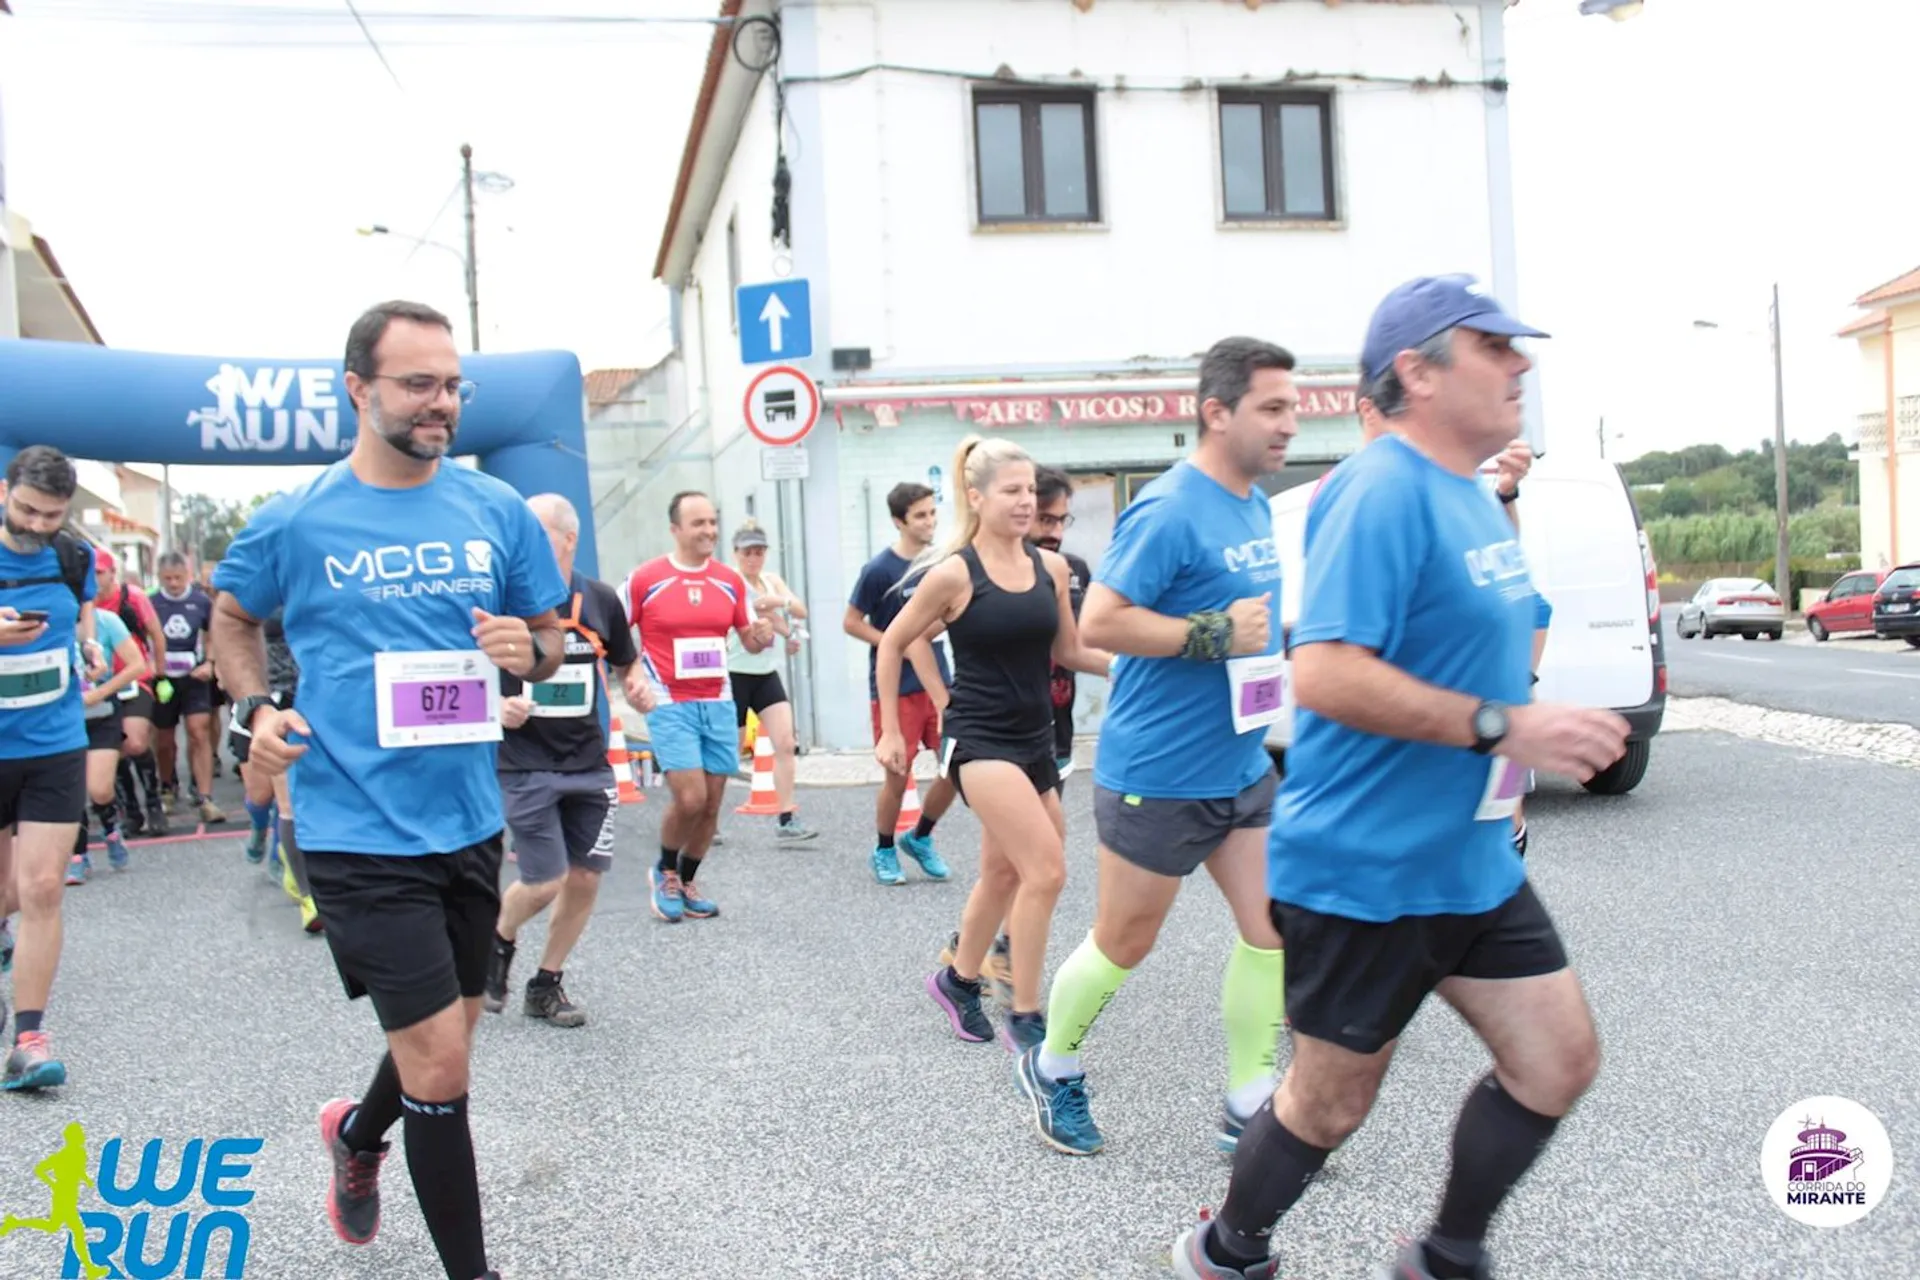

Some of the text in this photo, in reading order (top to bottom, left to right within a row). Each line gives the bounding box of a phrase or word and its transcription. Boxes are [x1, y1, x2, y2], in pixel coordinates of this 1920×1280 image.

[236, 367, 338, 409] WE
[324, 541, 454, 589] MCG
[382, 577, 494, 600] RUNNERS
[421, 684, 460, 712] 672
[552, 684, 568, 698] 22
